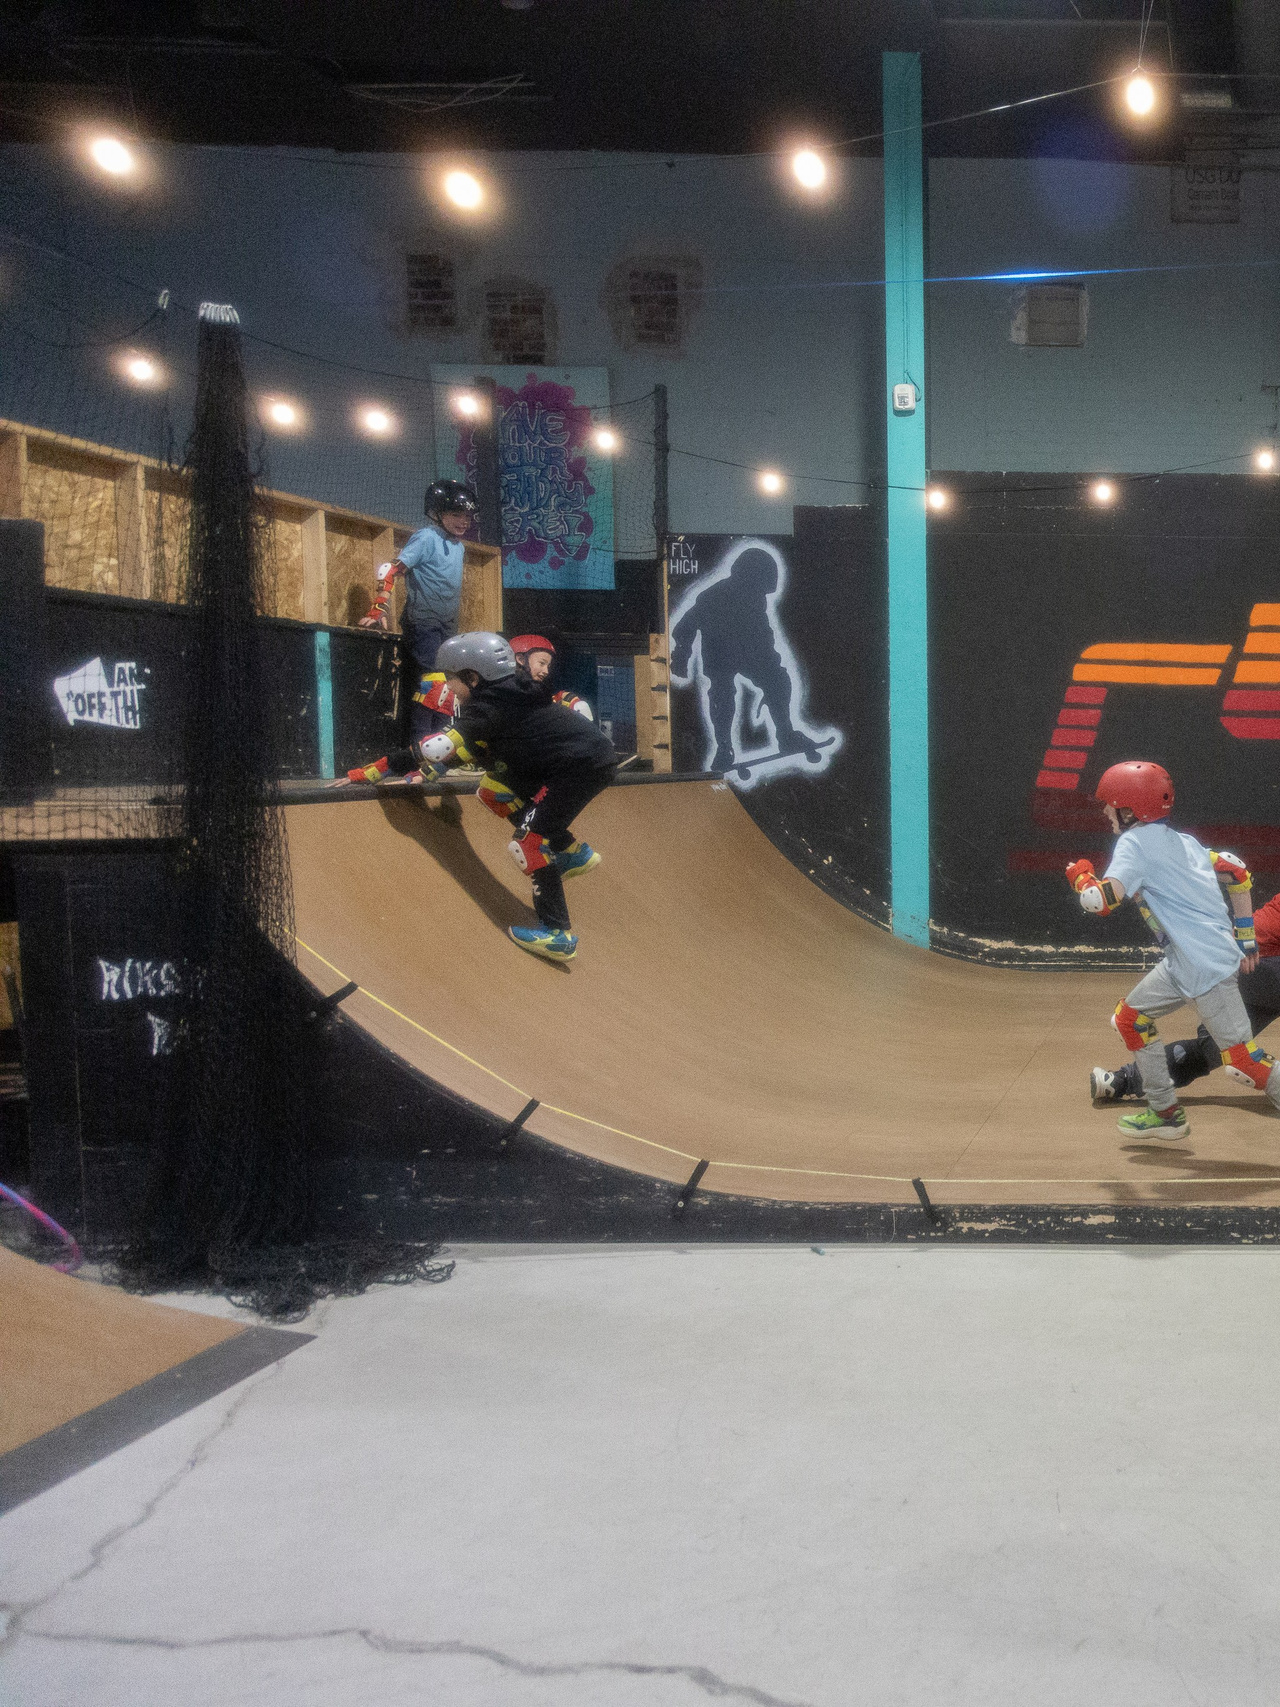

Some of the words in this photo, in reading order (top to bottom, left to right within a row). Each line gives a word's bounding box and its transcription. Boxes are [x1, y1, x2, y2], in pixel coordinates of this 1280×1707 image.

[472, 402, 570, 446] AVE
[468, 445, 573, 477] OUR
[671, 542, 696, 558] FLY
[670, 559, 699, 575] HIGH
